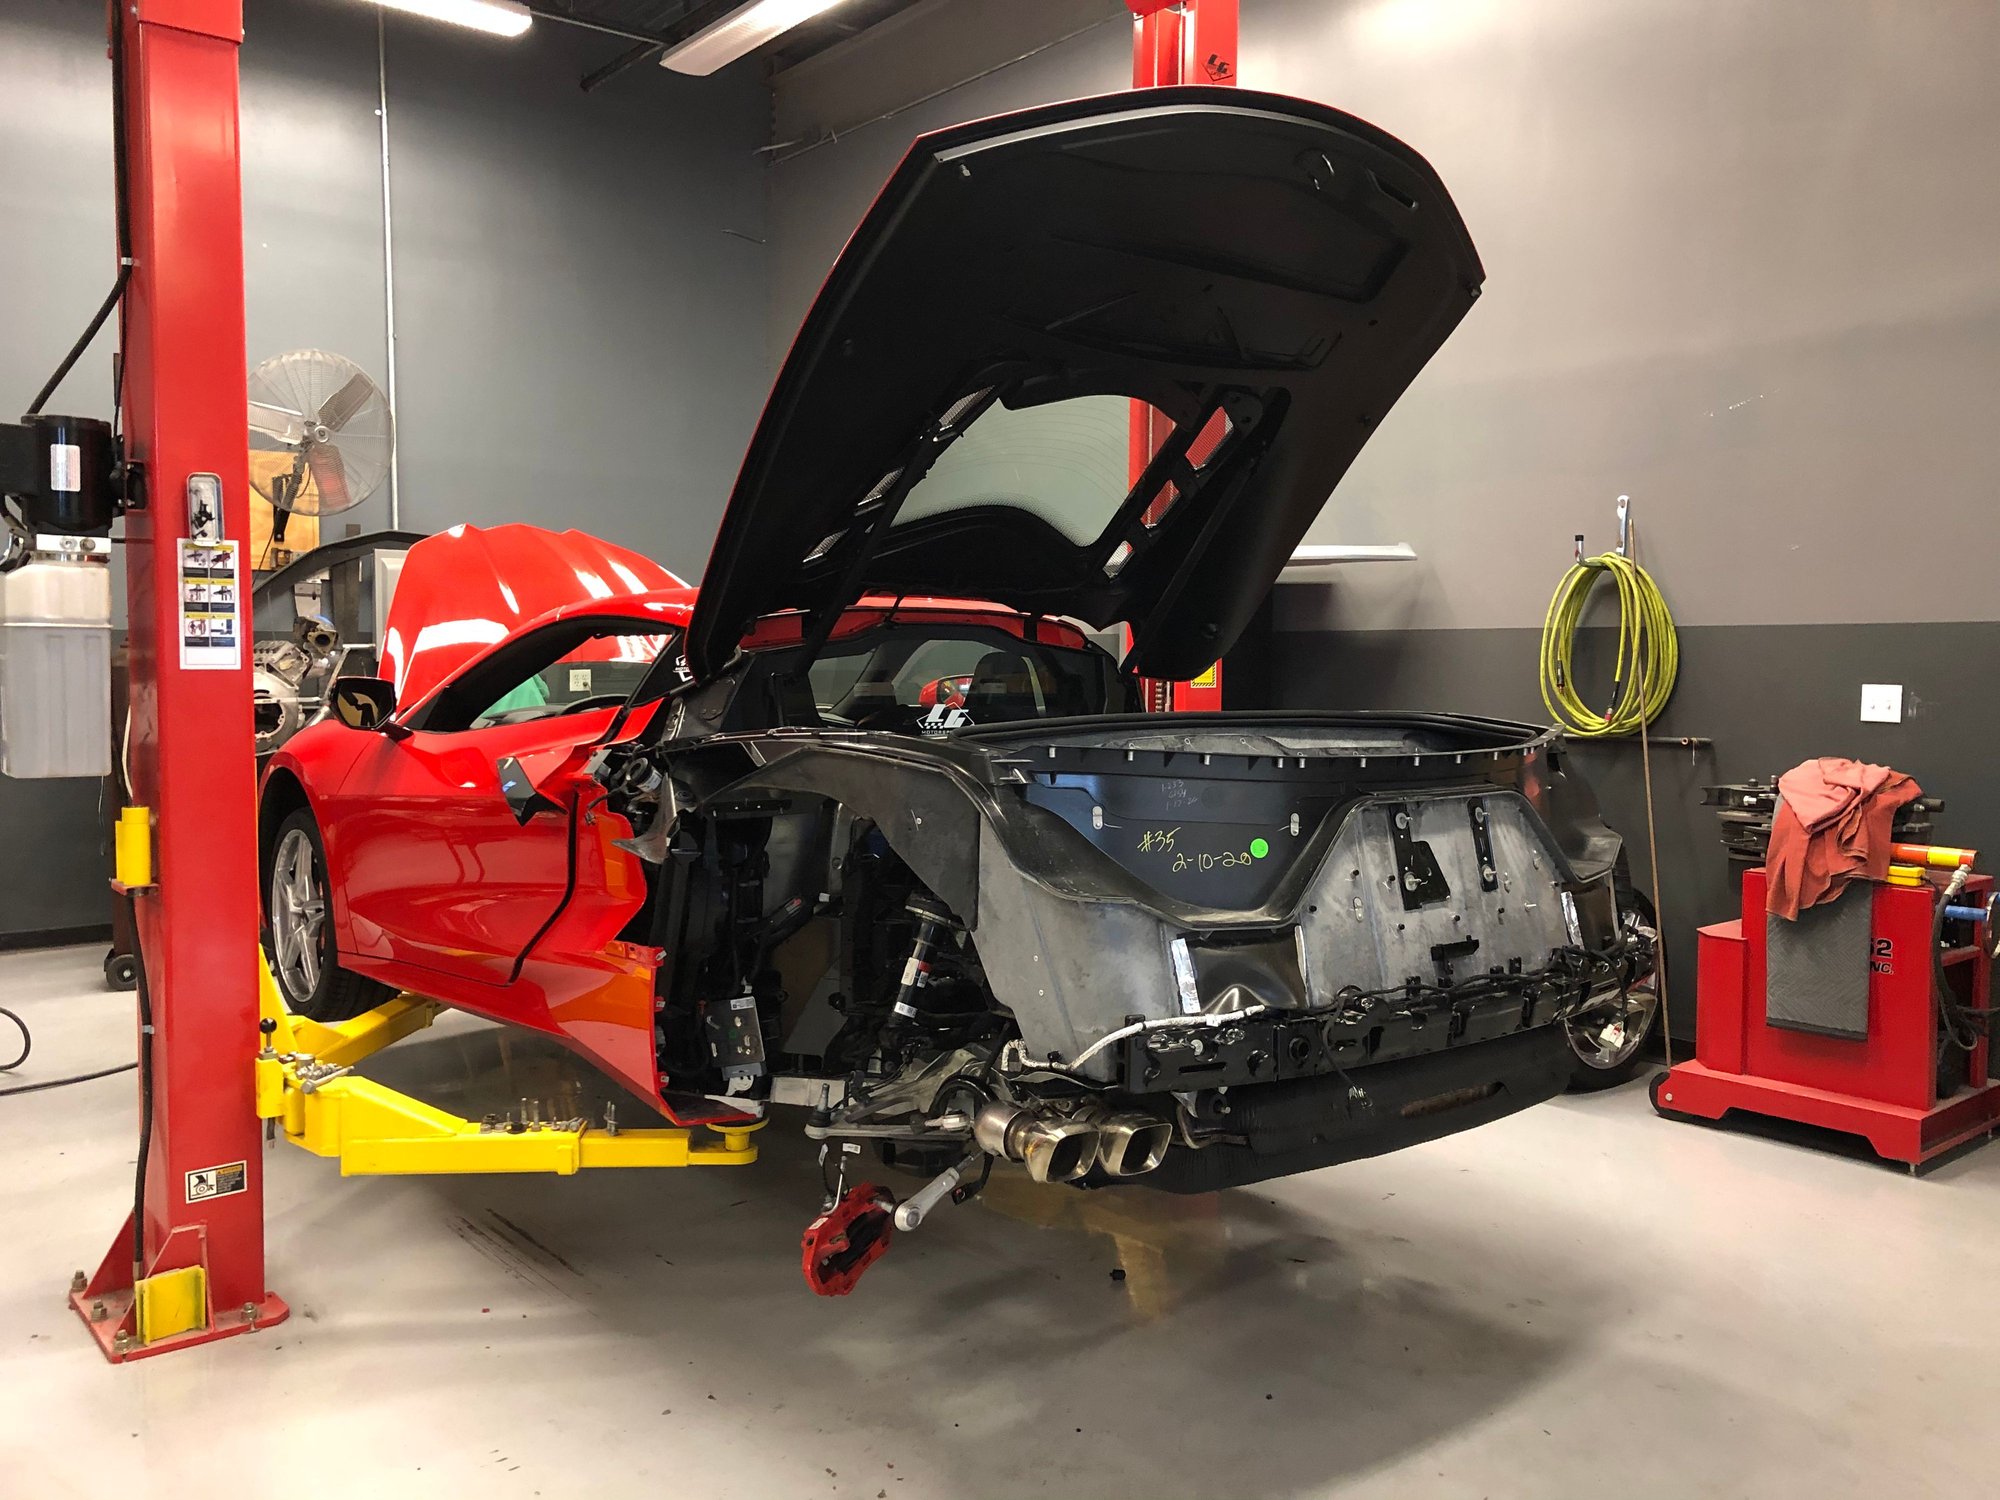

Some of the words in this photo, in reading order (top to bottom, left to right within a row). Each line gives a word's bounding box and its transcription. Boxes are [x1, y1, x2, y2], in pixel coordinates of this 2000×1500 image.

[1137, 826, 1181, 852] #35
[1172, 851, 1252, 872] 2-10-20
[1869, 960, 1894, 975] NC.
